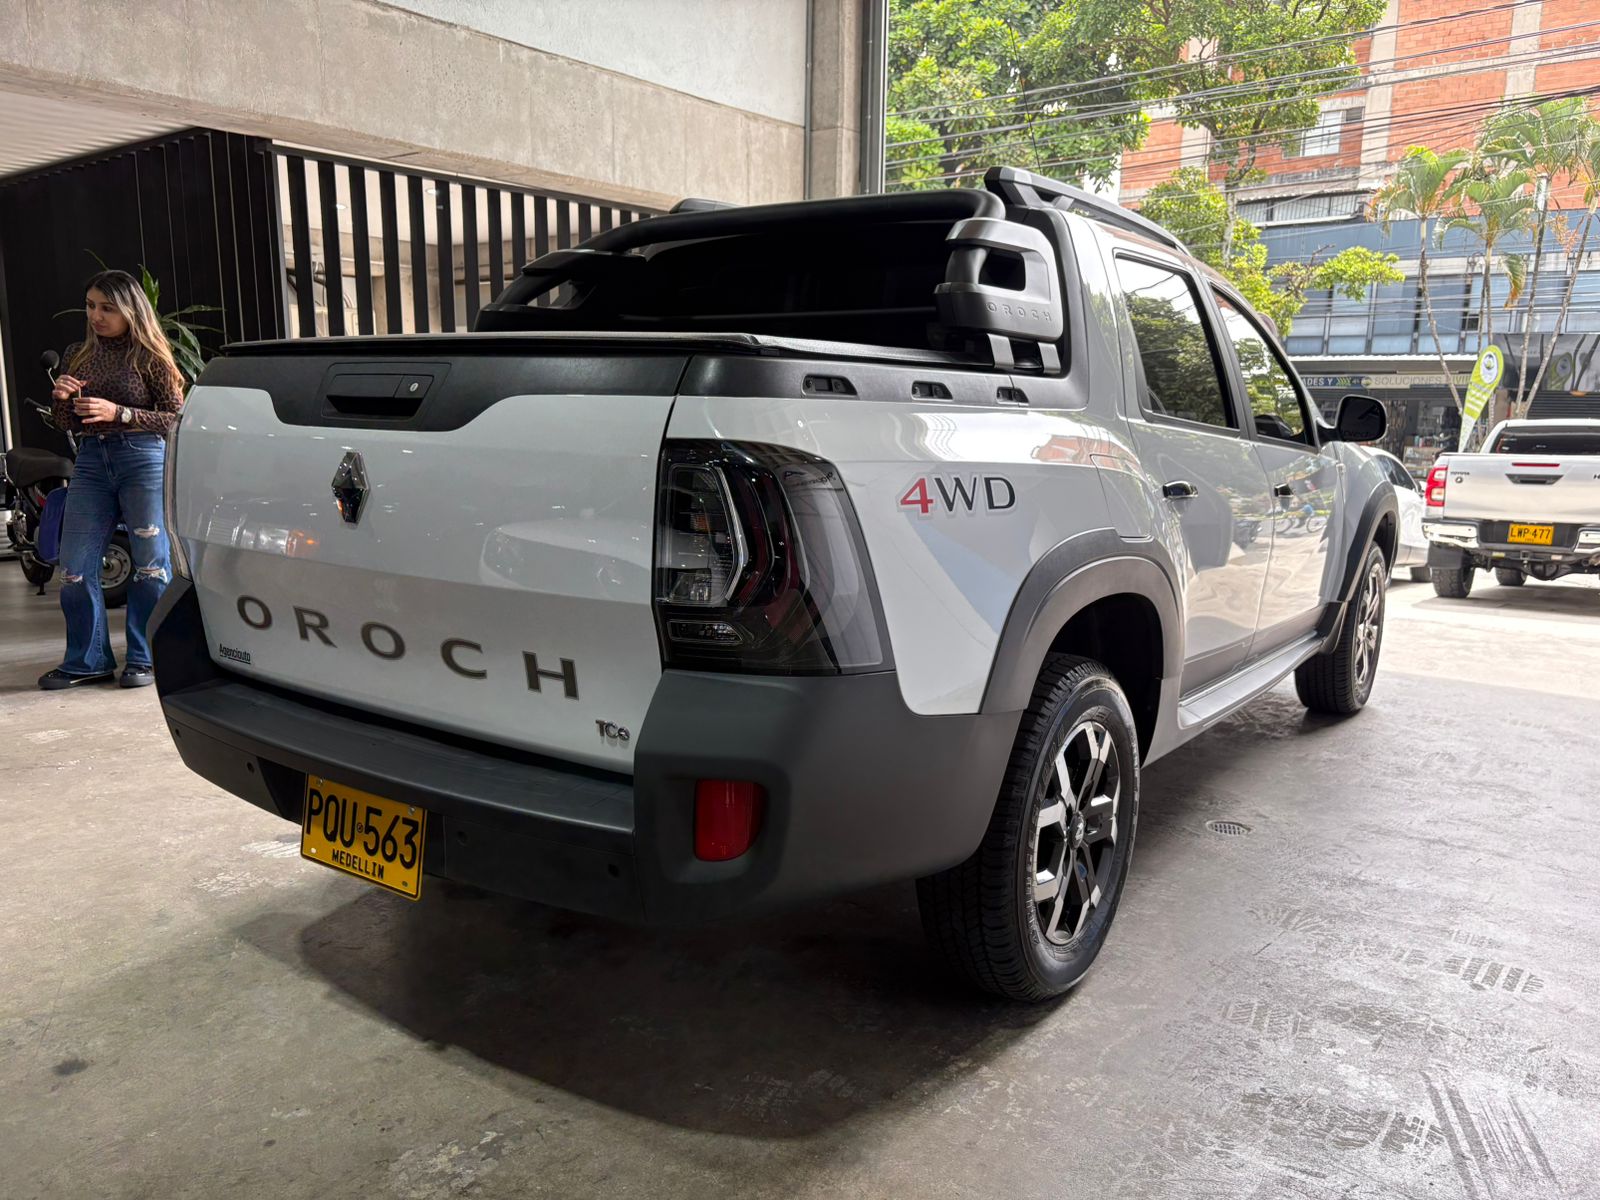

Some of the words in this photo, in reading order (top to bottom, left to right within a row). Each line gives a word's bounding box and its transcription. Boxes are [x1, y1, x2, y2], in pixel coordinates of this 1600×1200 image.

[986, 301, 1052, 322] OROCH
[1374, 375, 1442, 386] SOLUCIONES
[899, 475, 1017, 514] 4WD
[236, 595, 580, 700] OROCH
[331, 848, 385, 880] MEDELLIN
